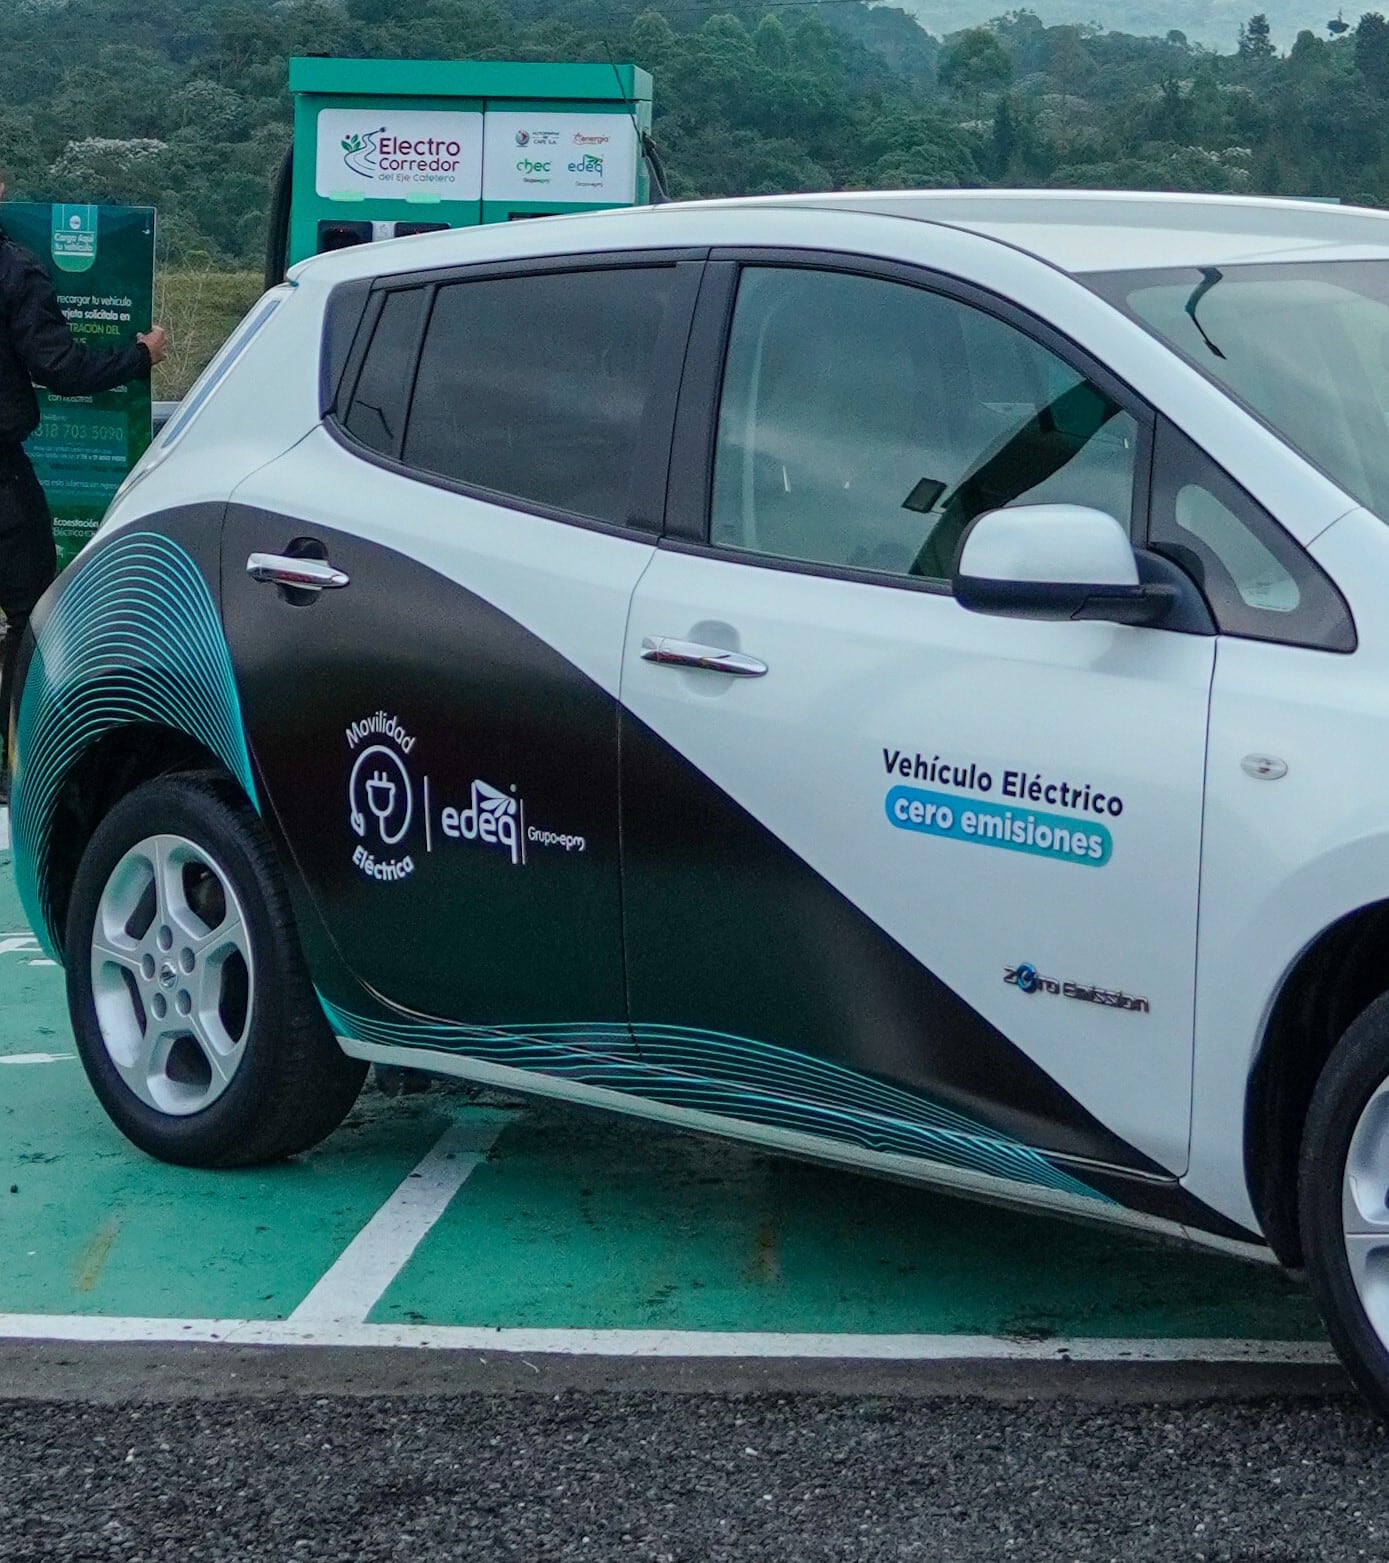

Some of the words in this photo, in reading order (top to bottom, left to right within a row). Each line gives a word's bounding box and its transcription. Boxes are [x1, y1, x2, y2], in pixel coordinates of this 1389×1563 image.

[380, 136, 461, 156] Electro
[379, 157, 460, 172] Corredor
[516, 158, 552, 174] chec
[567, 154, 604, 178] edeq
[378, 173, 394, 181] del
[396, 173, 410, 183] Eje
[413, 173, 456, 182] Cafetero
[92, 295, 100, 305] tu
[120, 313, 130, 321] en
[106, 325, 121, 335] DEL
[346, 711, 416, 754] Movilidad
[883, 748, 992, 792] Vehículo
[1002, 770, 1123, 817] Eléctrico
[442, 779, 517, 865] edeq
[894, 798, 953, 829] cero
[961, 811, 1103, 859] emisiones
[352, 845, 414, 881] Eléctrica
[1063, 981, 1149, 1013] Emission
